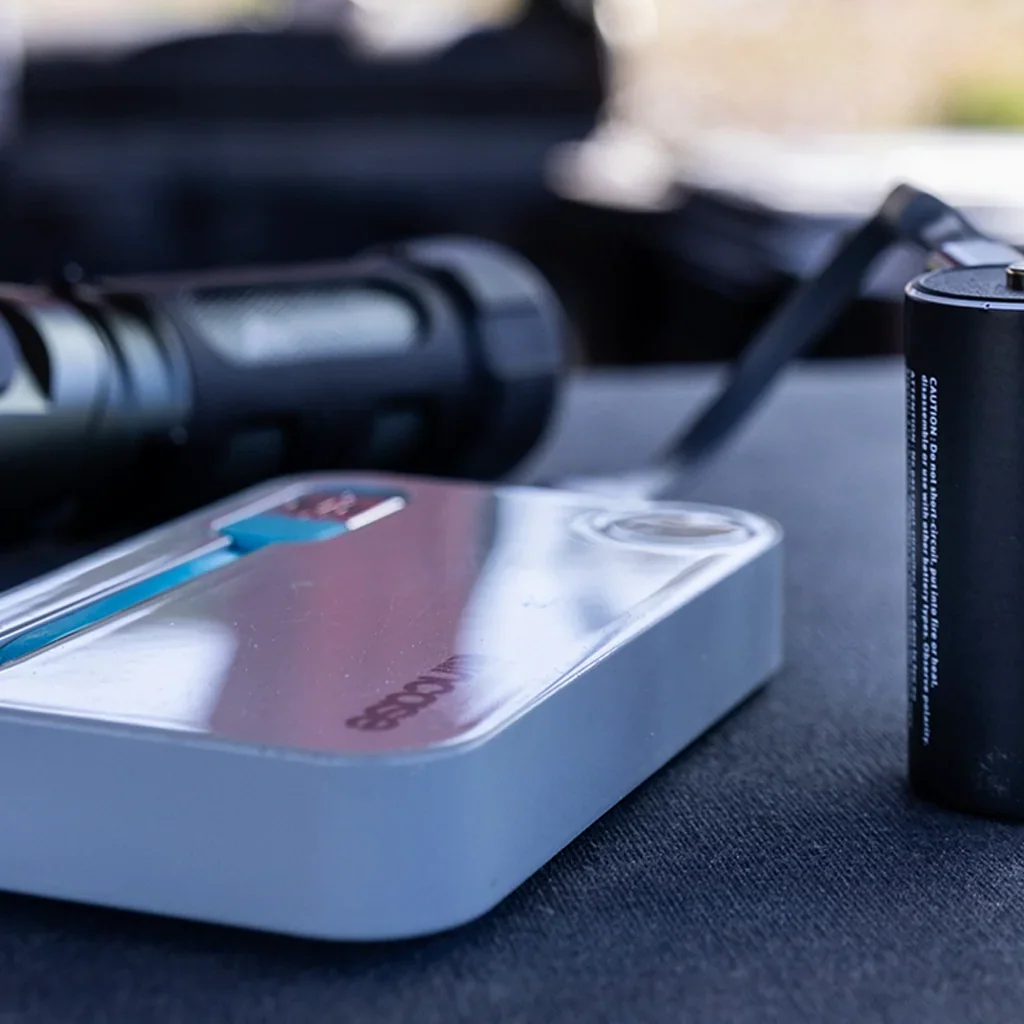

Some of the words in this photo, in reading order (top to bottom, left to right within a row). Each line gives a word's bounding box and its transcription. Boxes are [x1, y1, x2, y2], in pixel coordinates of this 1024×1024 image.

[921, 374, 929, 451] disassemble
[929, 377, 938, 436] CAUTION
[922, 453, 928, 466] or
[929, 443, 938, 461] Do
[930, 463, 938, 484] not
[922, 492, 930, 519] with
[922, 521, 930, 555] other
[922, 556, 930, 602] battery
[930, 567, 938, 589] put
[930, 591, 939, 616] into
[930, 618, 939, 640] fire
[930, 641, 938, 656] or
[923, 642, 931, 693] Observe
